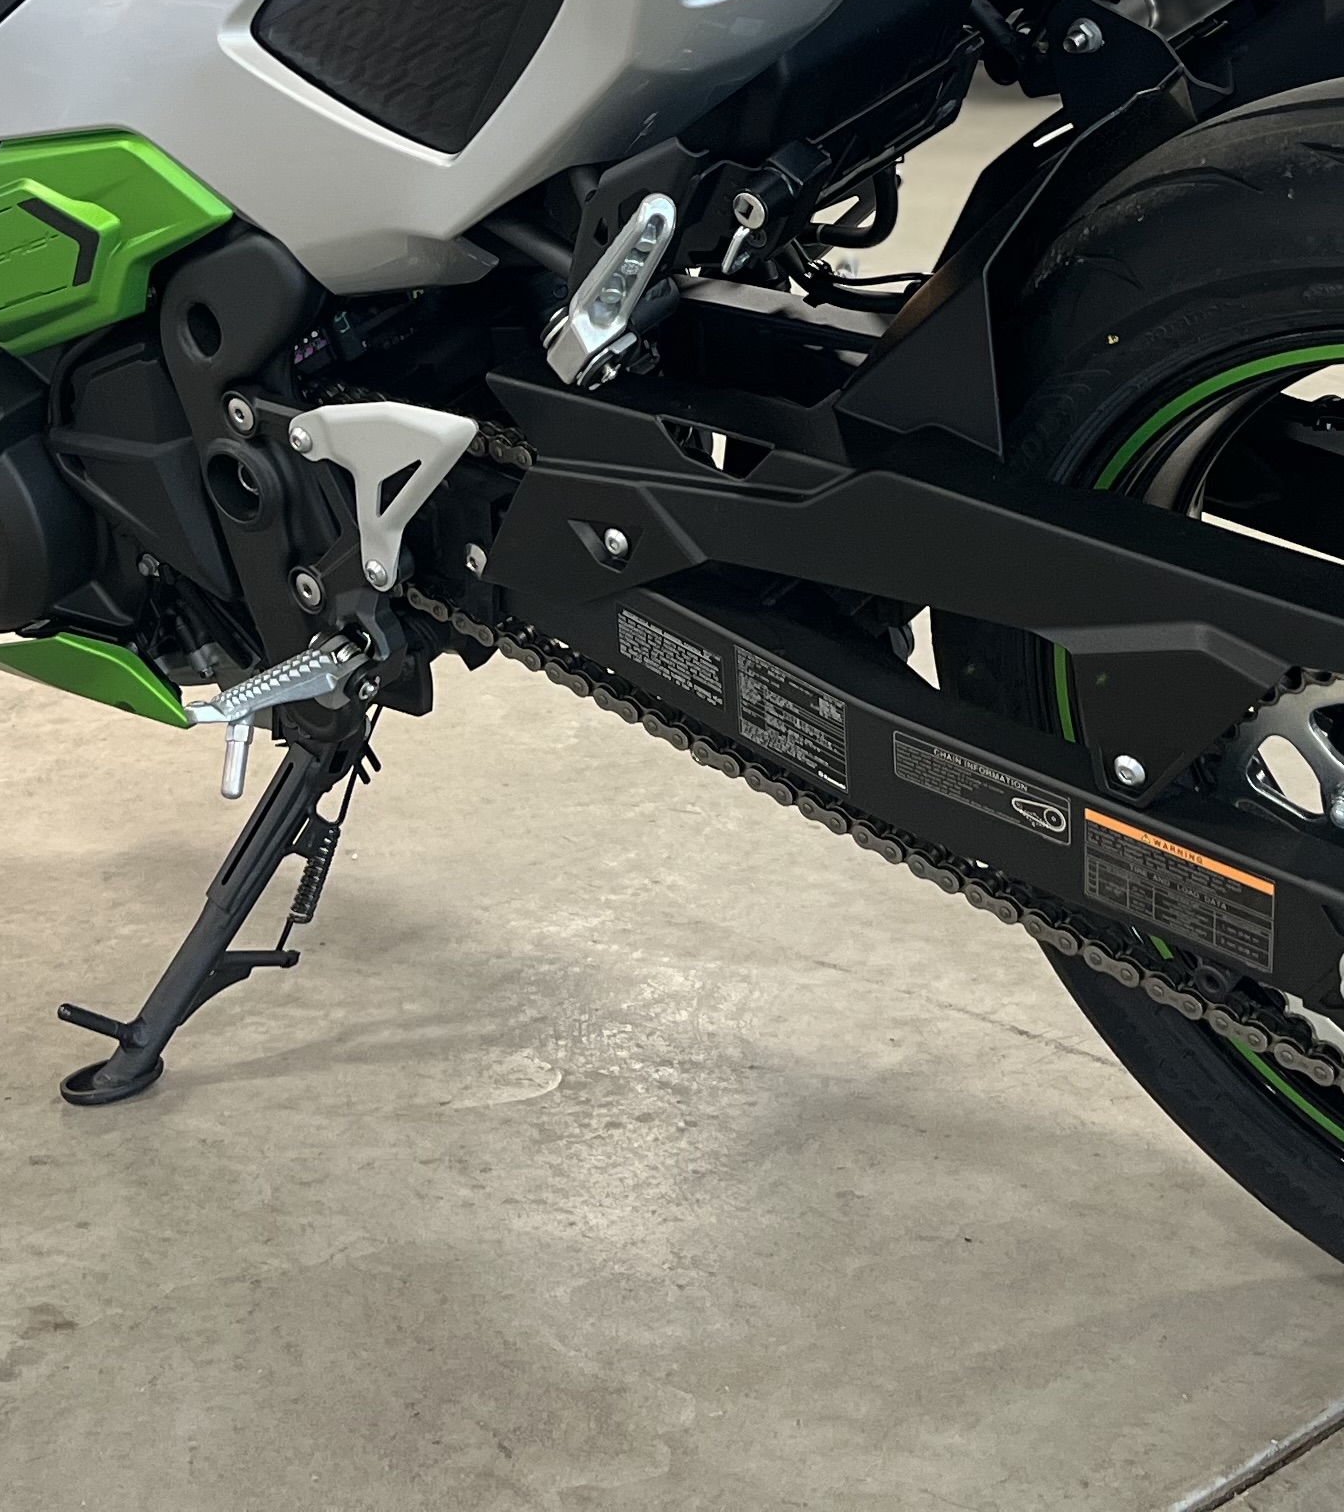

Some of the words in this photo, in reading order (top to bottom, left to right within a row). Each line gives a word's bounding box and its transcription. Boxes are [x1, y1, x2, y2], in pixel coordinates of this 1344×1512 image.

[933, 747, 962, 765] CHAIN
[963, 760, 1028, 792] INFORMATION
[1152, 838, 1204, 865] WARNING
[1204, 893, 1227, 910] DATA
